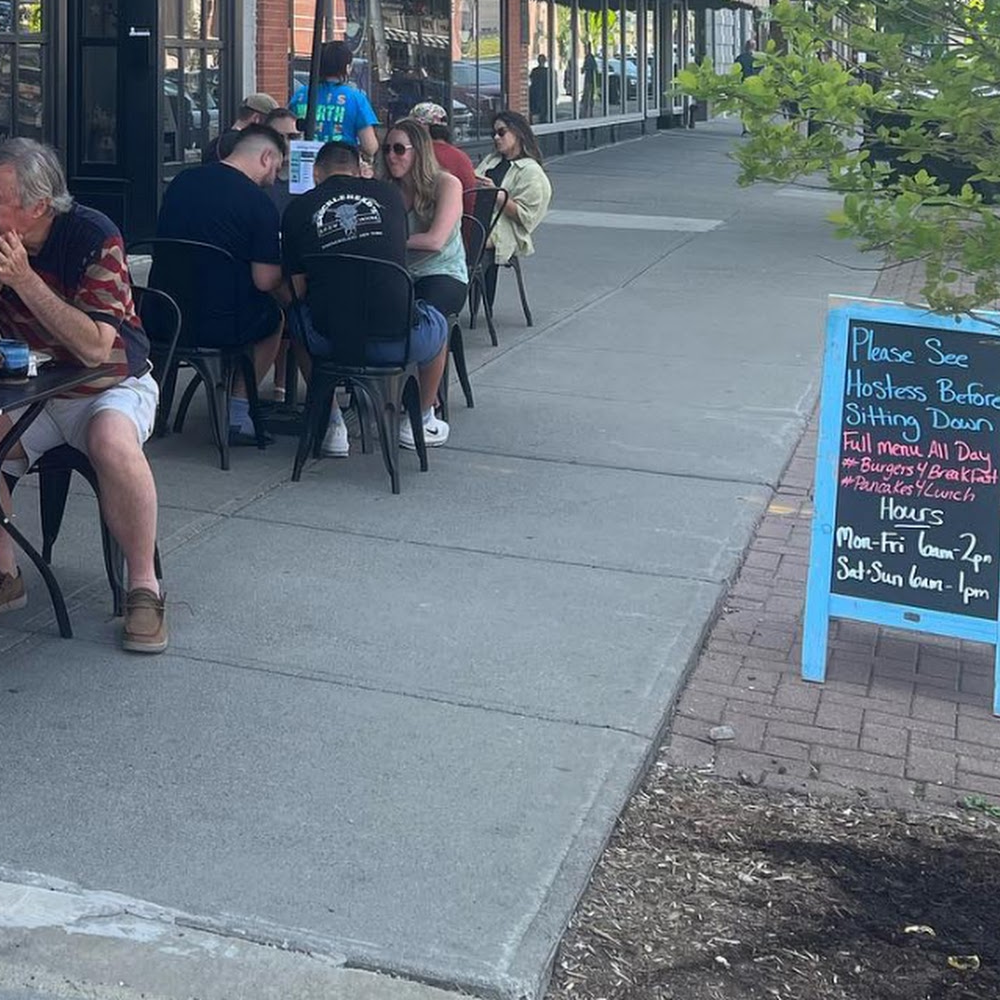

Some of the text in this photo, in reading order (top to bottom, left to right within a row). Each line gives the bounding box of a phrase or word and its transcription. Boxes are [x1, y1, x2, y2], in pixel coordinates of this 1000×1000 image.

[852, 326, 969, 368] Please See
[846, 368, 1000, 410] Hostess Before
[845, 402, 994, 443] Sitting Down
[842, 431, 871, 453] Full
[928, 440, 949, 460] All
[954, 440, 992, 474] Day
[880, 496, 945, 526] Hours
[836, 526, 905, 553] Mon-Fri
